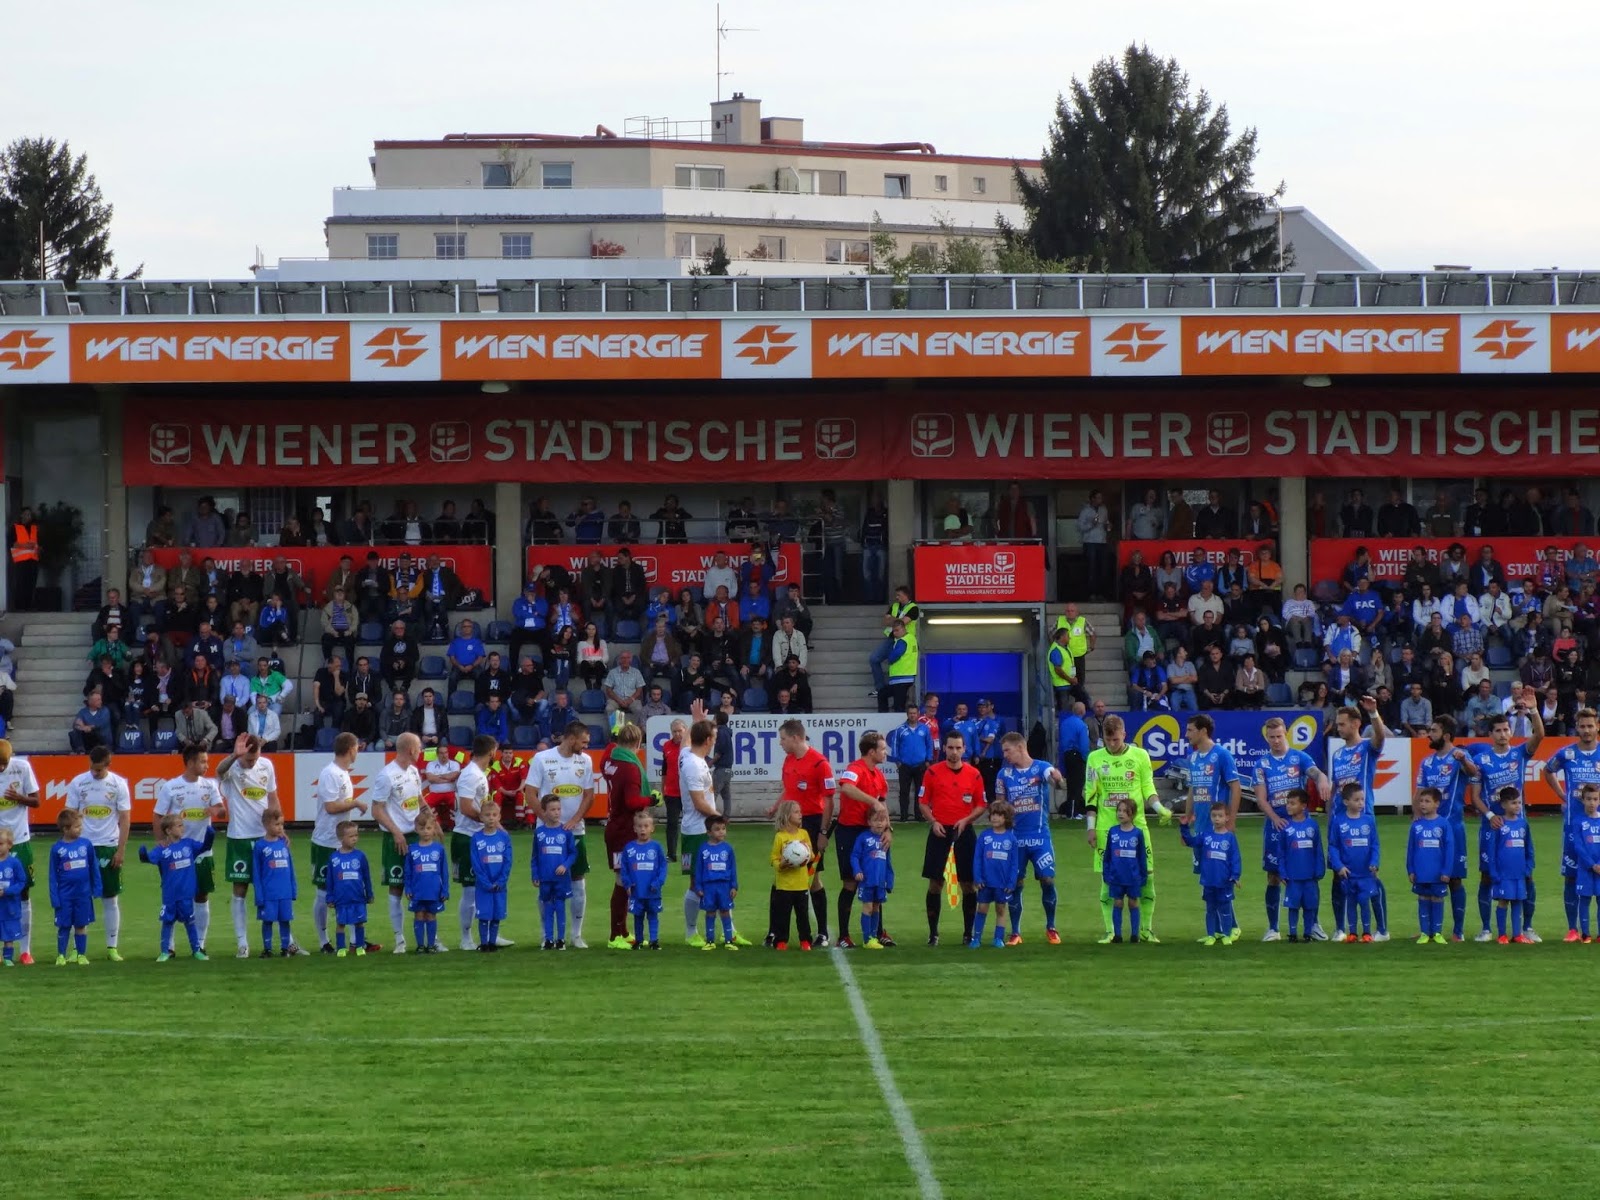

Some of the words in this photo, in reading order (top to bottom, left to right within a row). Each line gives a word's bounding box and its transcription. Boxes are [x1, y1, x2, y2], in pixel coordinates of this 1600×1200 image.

[85, 336, 177, 361] WIEN
[184, 335, 340, 360] ENERGIE
[455, 334, 546, 359] WIEN
[553, 333, 709, 358] ENERGIE
[828, 332, 919, 357] WIEN
[926, 331, 1081, 355] ENERGIE
[1197, 329, 1288, 354] WIEN
[1295, 328, 1450, 352] ENERGIE
[202, 422, 417, 465] WIENER
[484, 418, 803, 462] STÄDTISCHE
[966, 412, 1194, 458] WIENER
[1264, 410, 1600, 455] STÄDTISCHE
[945, 563, 993, 574] WIENER
[946, 574, 1015, 585] STÄDTISCHE
[1355, 600, 1375, 610] FAC
[729, 719, 778, 729] PEZIALIST
[807, 718, 868, 728] TEAMSPORT
[124, 732, 140, 740] VIP
[157, 731, 173, 740] VIP
